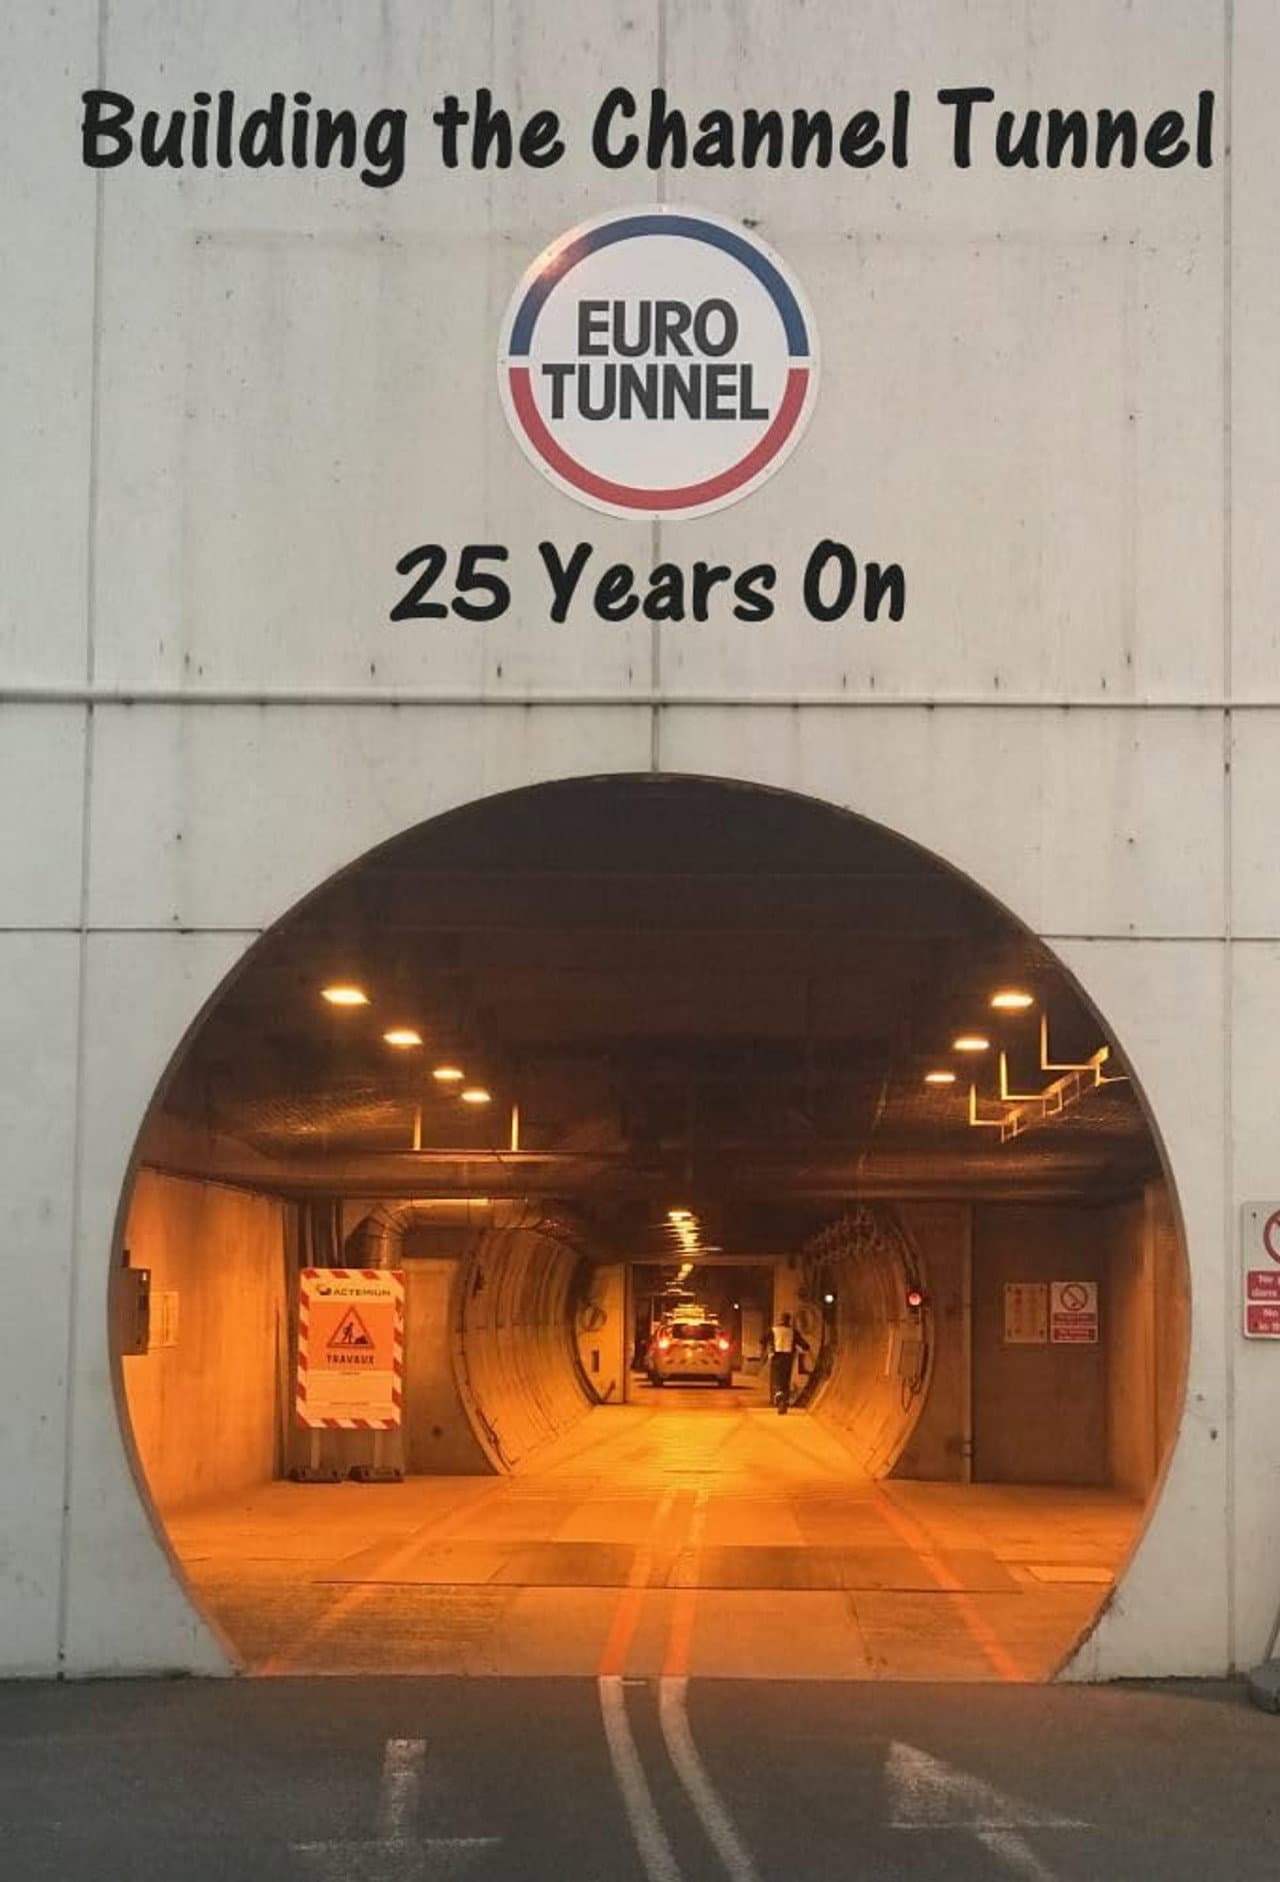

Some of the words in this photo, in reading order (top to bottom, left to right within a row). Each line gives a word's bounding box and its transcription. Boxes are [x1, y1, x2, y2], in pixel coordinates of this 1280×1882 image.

[577, 298, 738, 357] EURO
[542, 363, 769, 421] TUNNEL
[327, 1354, 375, 1365] TRAVAUX
